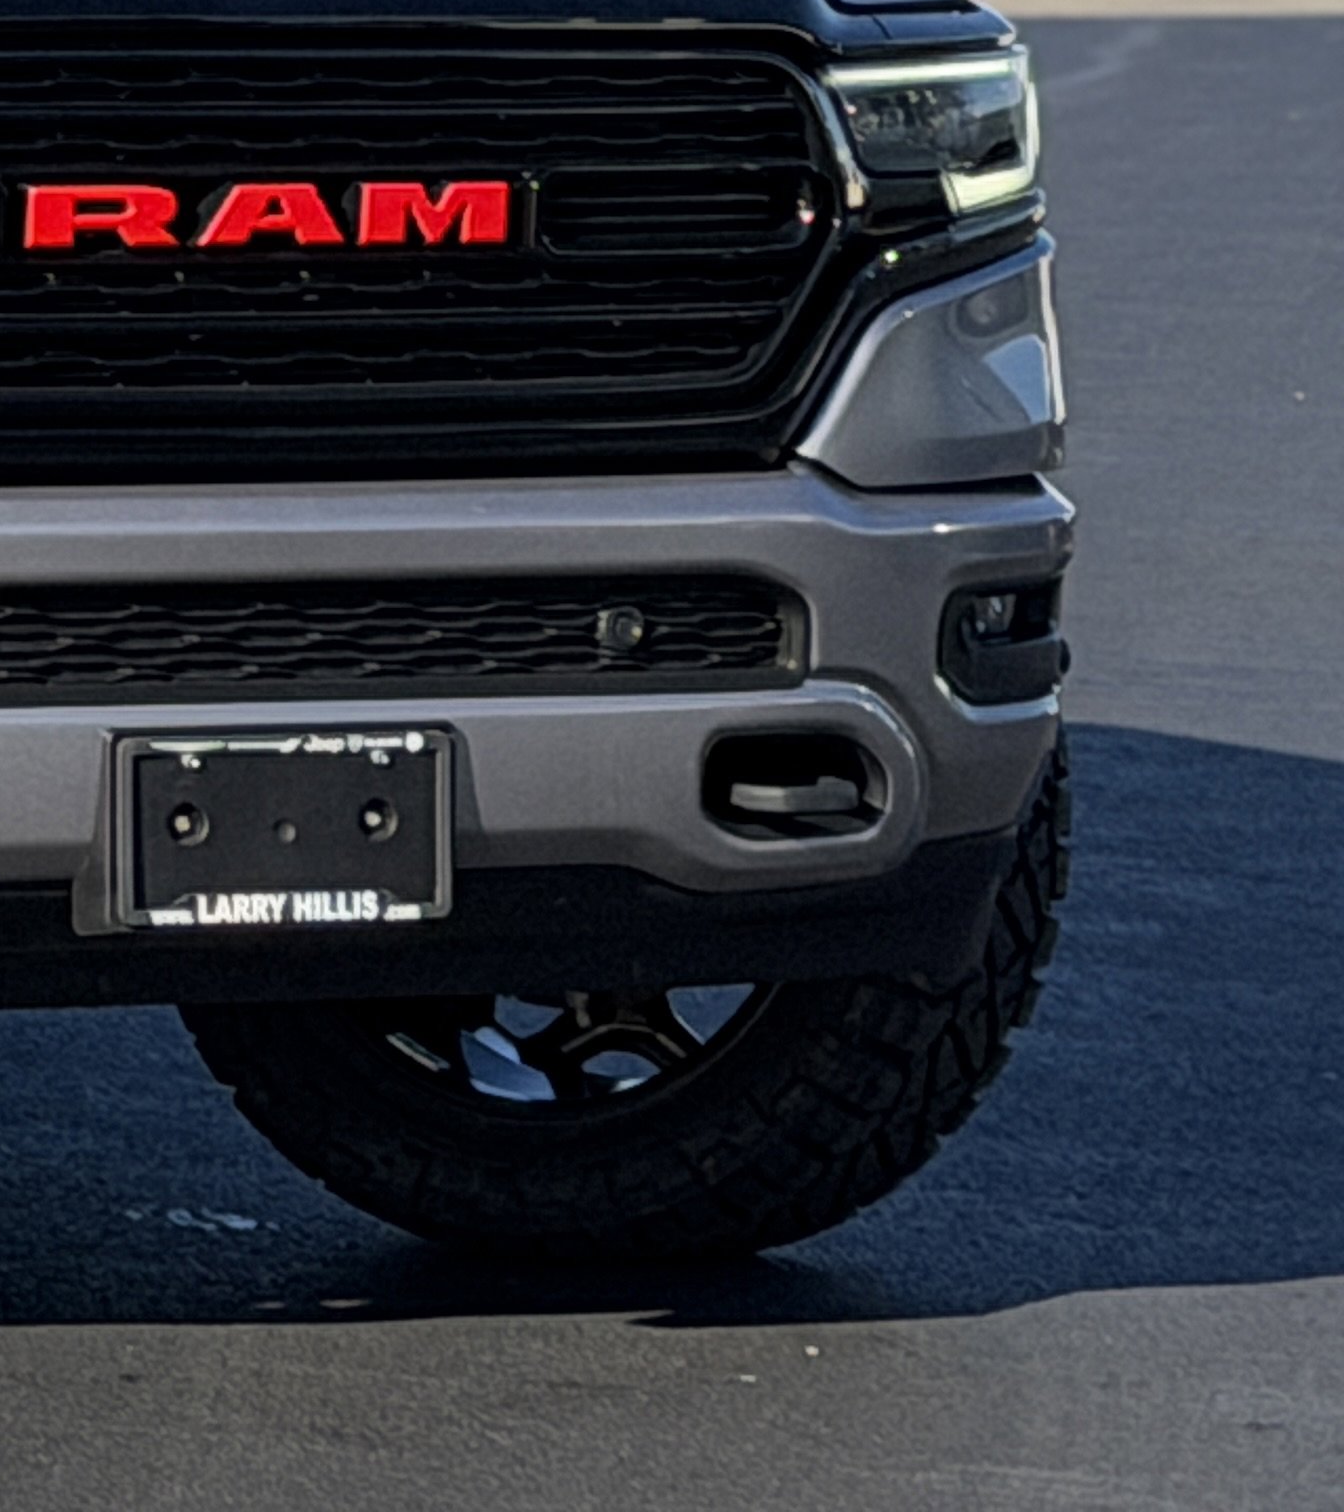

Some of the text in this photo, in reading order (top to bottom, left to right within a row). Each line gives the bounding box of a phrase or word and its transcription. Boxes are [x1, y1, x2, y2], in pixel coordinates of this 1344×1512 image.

[24, 181, 508, 249] RAM
[196, 892, 287, 924] LARRY
[292, 889, 379, 923] HILLIS
